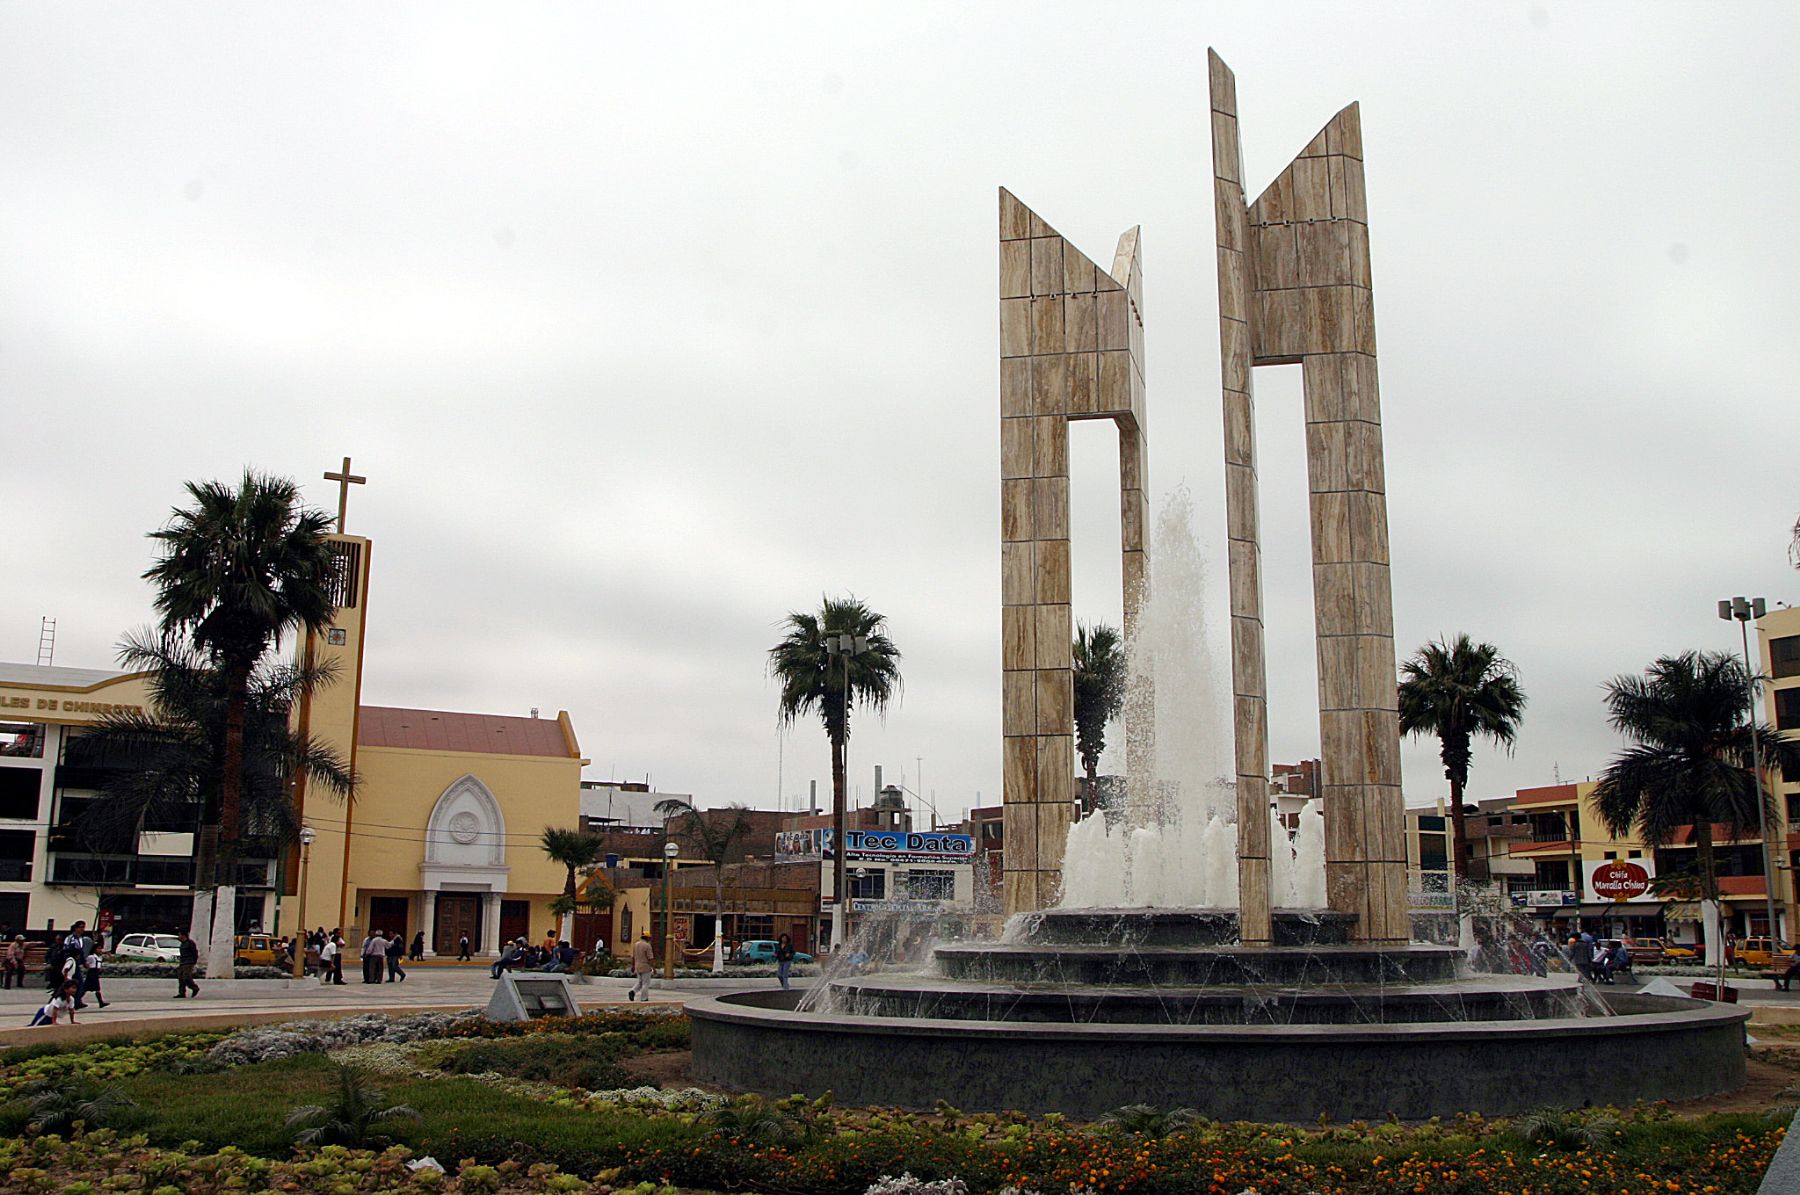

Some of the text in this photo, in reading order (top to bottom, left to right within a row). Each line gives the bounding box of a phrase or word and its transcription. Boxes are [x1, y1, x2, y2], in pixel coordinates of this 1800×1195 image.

[0, 696, 143, 716] LES DE CHIMBOTE
[846, 831, 967, 852] Tec Data
[1609, 870, 1628, 879] Chifa
[1595, 880, 1645, 890] Muralla China
